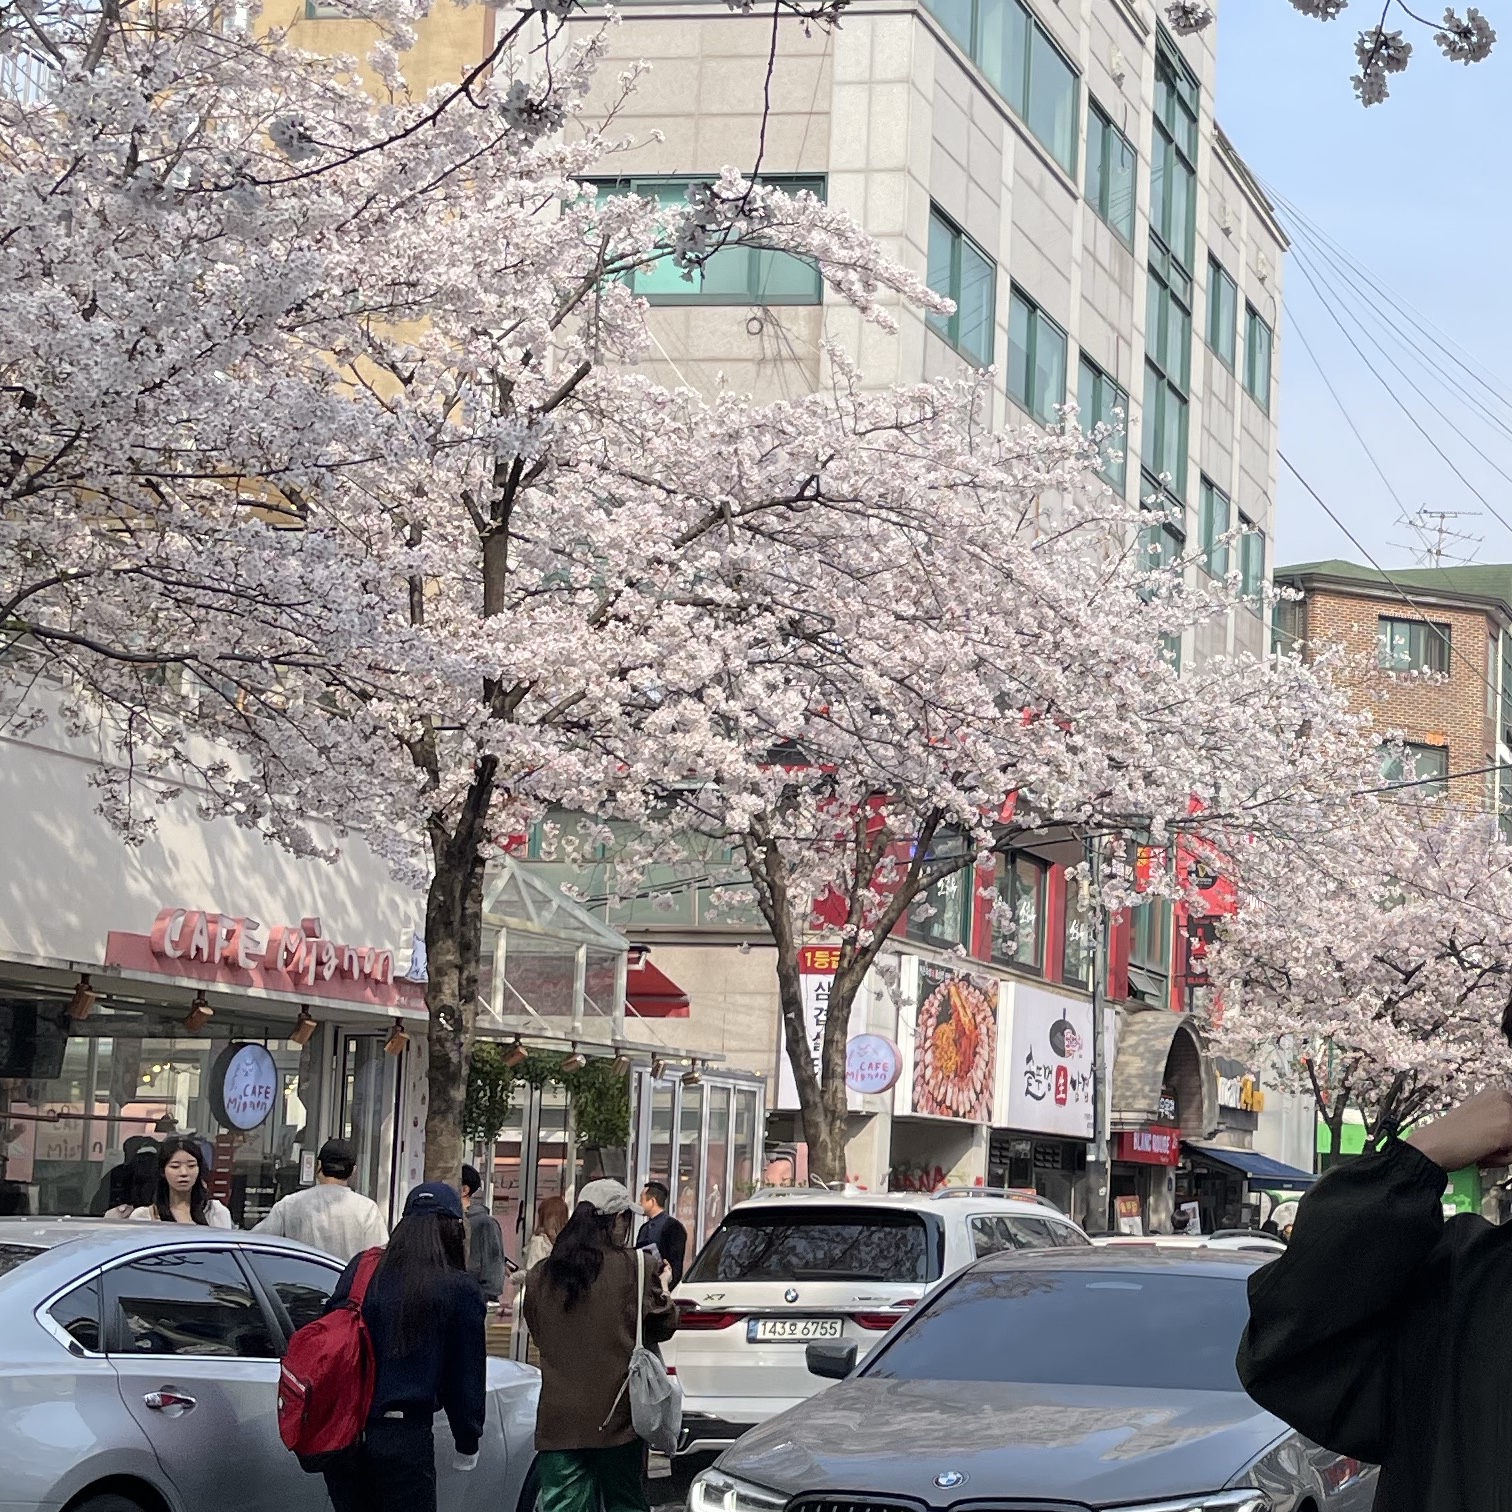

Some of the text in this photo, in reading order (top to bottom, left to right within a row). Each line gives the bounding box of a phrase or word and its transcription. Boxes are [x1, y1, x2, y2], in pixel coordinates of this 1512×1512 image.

[164, 908, 395, 985] CAFE Mignon
[859, 1062, 889, 1073] CAFE
[243, 1084, 272, 1099] CAFE
[703, 1293, 726, 1301] X7
[801, 1321, 838, 1336] 6755
